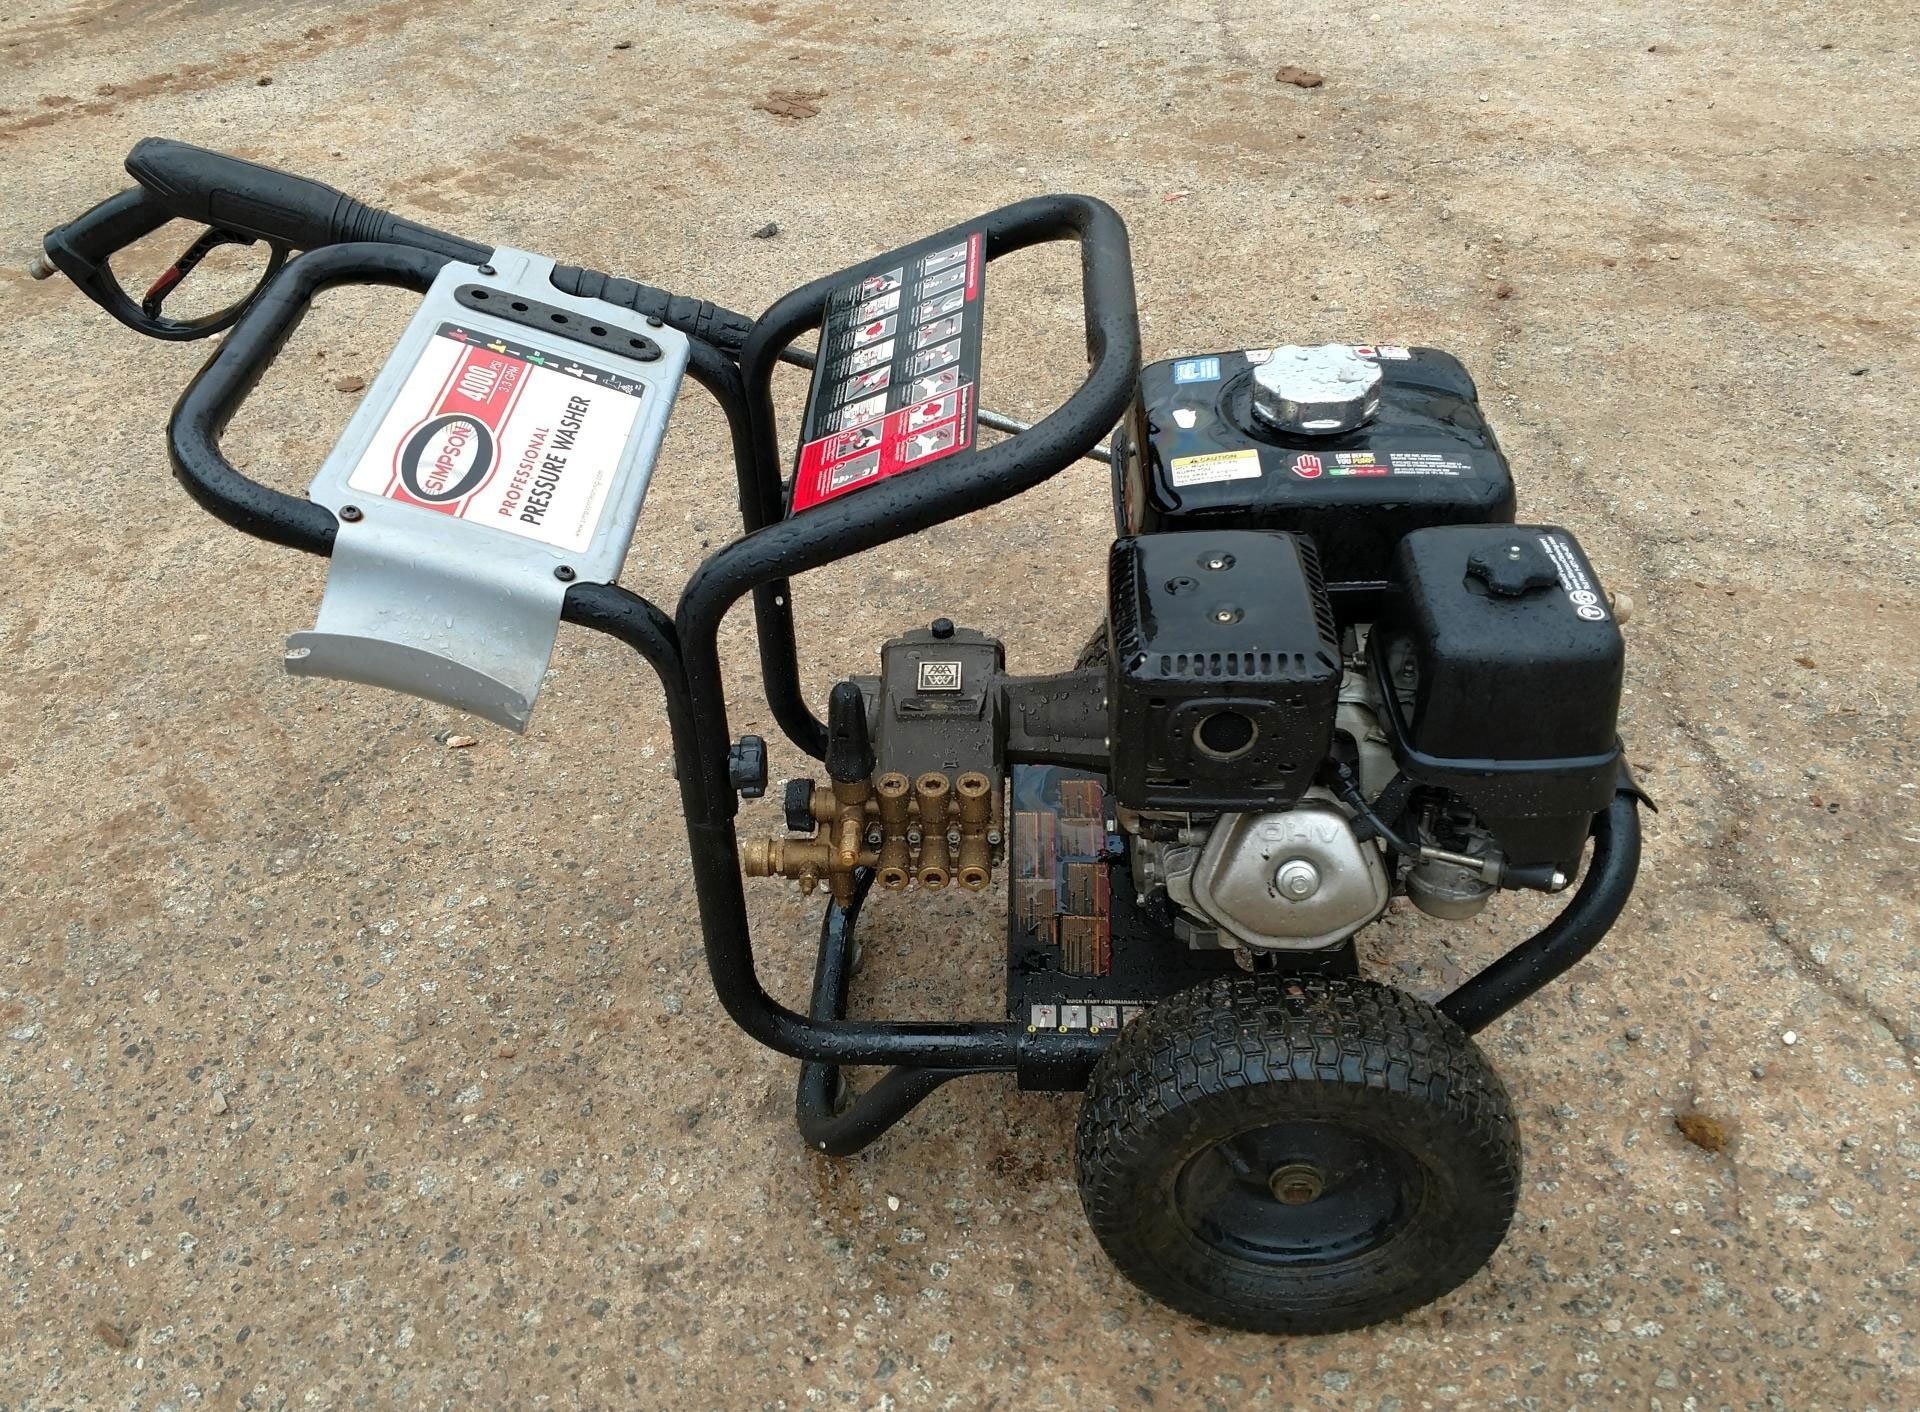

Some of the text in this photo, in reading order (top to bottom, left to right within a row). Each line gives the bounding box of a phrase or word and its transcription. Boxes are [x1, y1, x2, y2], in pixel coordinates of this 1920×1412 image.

[456, 360, 503, 402] 4000 PSI
[498, 365, 520, 393] 3.3 GPM
[425, 425, 472, 492] SIMPSON
[498, 426, 550, 517] PROFESSIONAL
[519, 453, 568, 526] PRESSURE
[551, 395, 591, 451] WASHER
[1200, 454, 1238, 463] CAUTION
[1258, 820, 1340, 843] OHV
